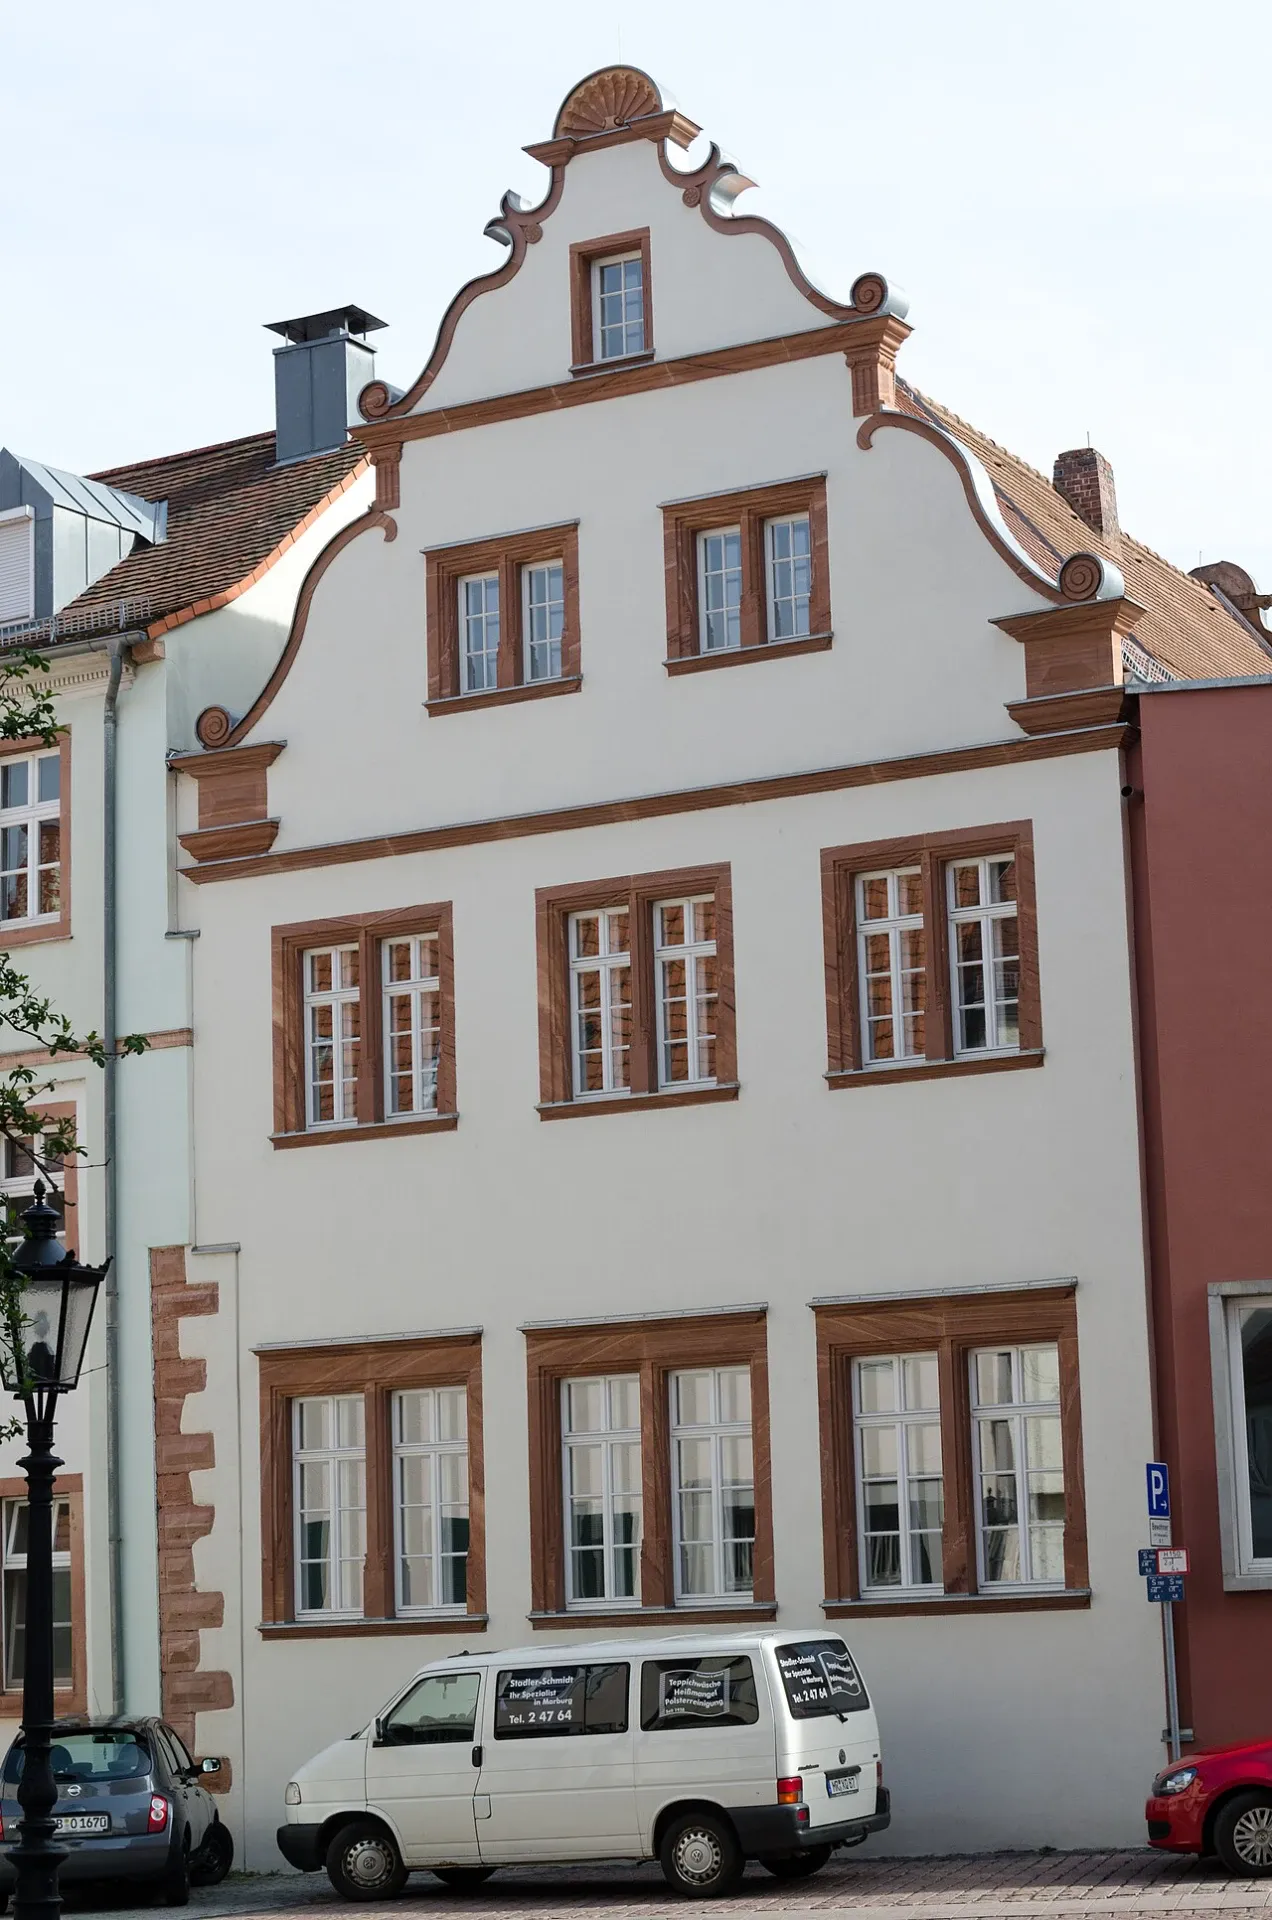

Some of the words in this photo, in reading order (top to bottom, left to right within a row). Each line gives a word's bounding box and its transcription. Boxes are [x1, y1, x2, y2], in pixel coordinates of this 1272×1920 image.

[1151, 1470, 1163, 1510] P
[669, 1678, 722, 1689] Teppichwäsche
[509, 1691, 520, 1699] Ihr
[522, 1690, 557, 1700] Spezialist
[674, 1688, 718, 1699] Heißmangel
[803, 1690, 809, 1702] 2
[809, 1688, 818, 1700] 47
[819, 1687, 828, 1699] 64
[542, 1697, 573, 1706] Marburg
[665, 1697, 724, 1708] Polsterreinigung
[509, 1714, 525, 1724] Tel.
[528, 1711, 536, 1723] 2
[539, 1710, 554, 1722] 47
[557, 1709, 572, 1721] 64
[80, 1816, 107, 1829] 1670
